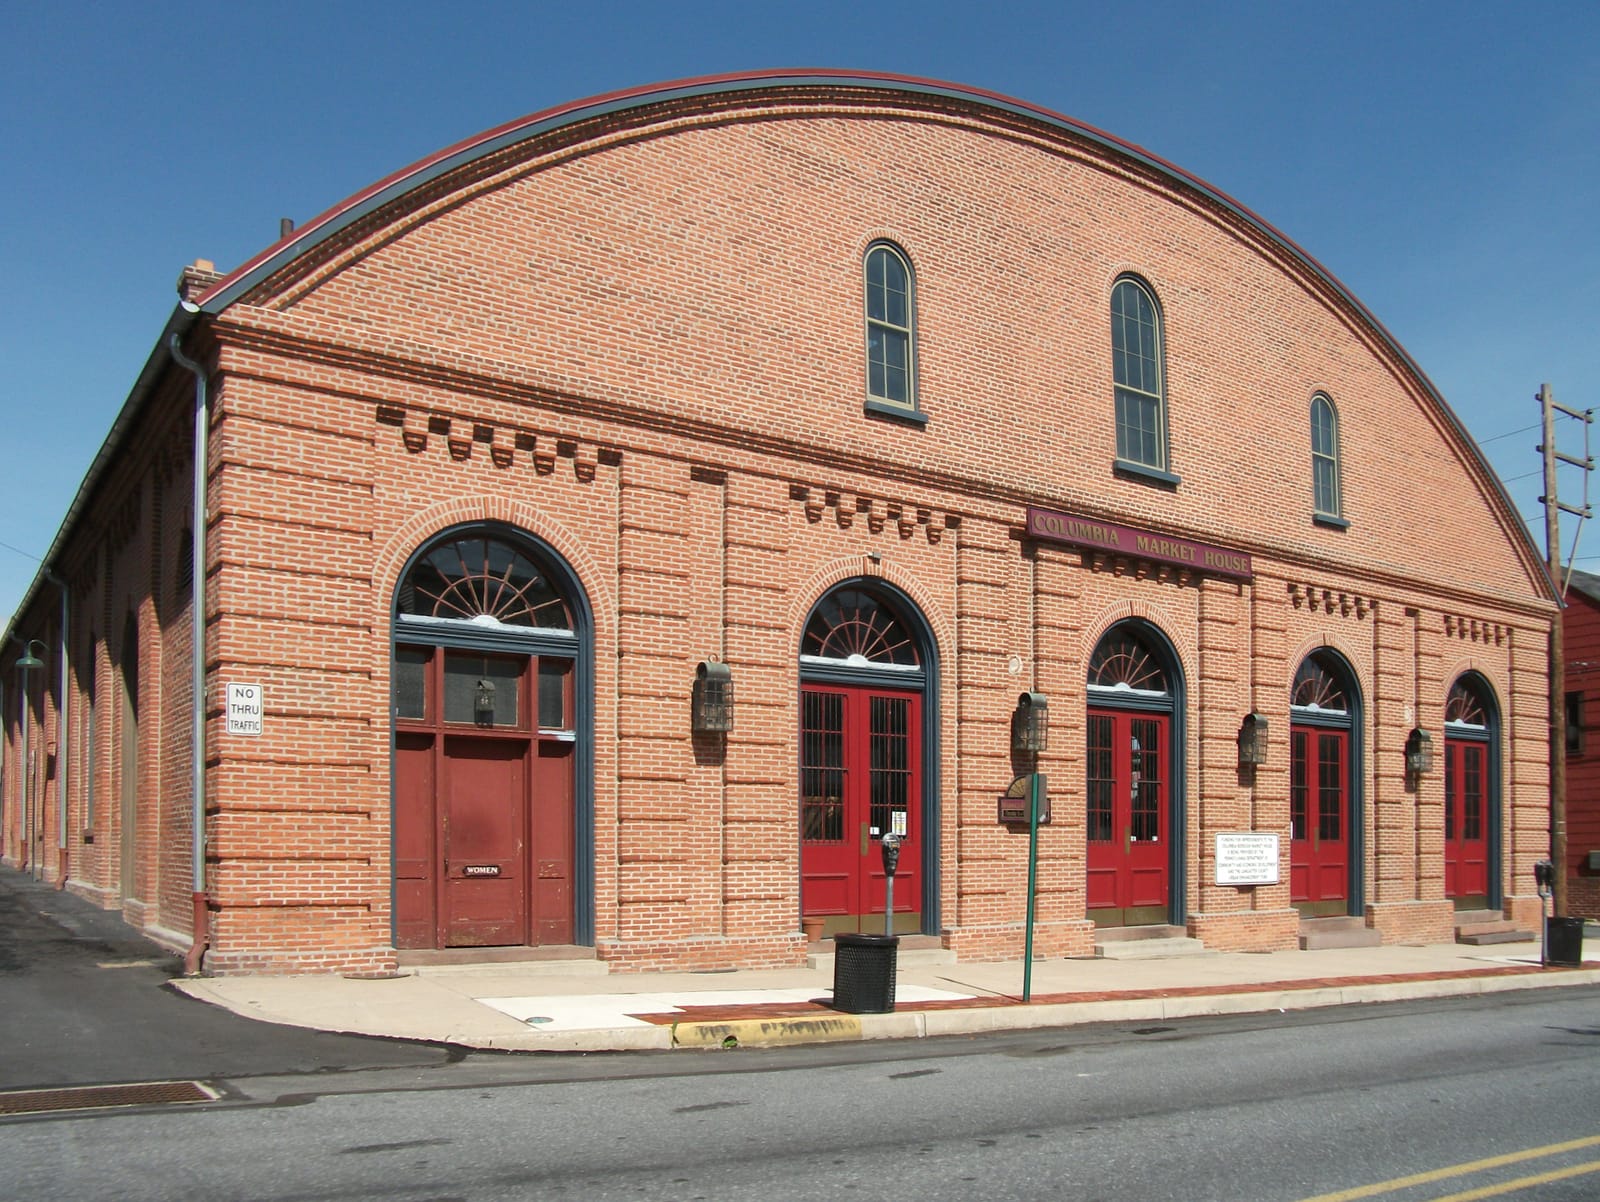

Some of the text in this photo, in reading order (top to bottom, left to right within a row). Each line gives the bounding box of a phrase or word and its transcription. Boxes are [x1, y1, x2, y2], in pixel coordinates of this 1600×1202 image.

[1034, 513, 1249, 573] COLUMBIA MARKET HOUSE
[235, 688, 254, 699] NO
[231, 704, 259, 715] THRU
[230, 720, 260, 731] TRAFFIC
